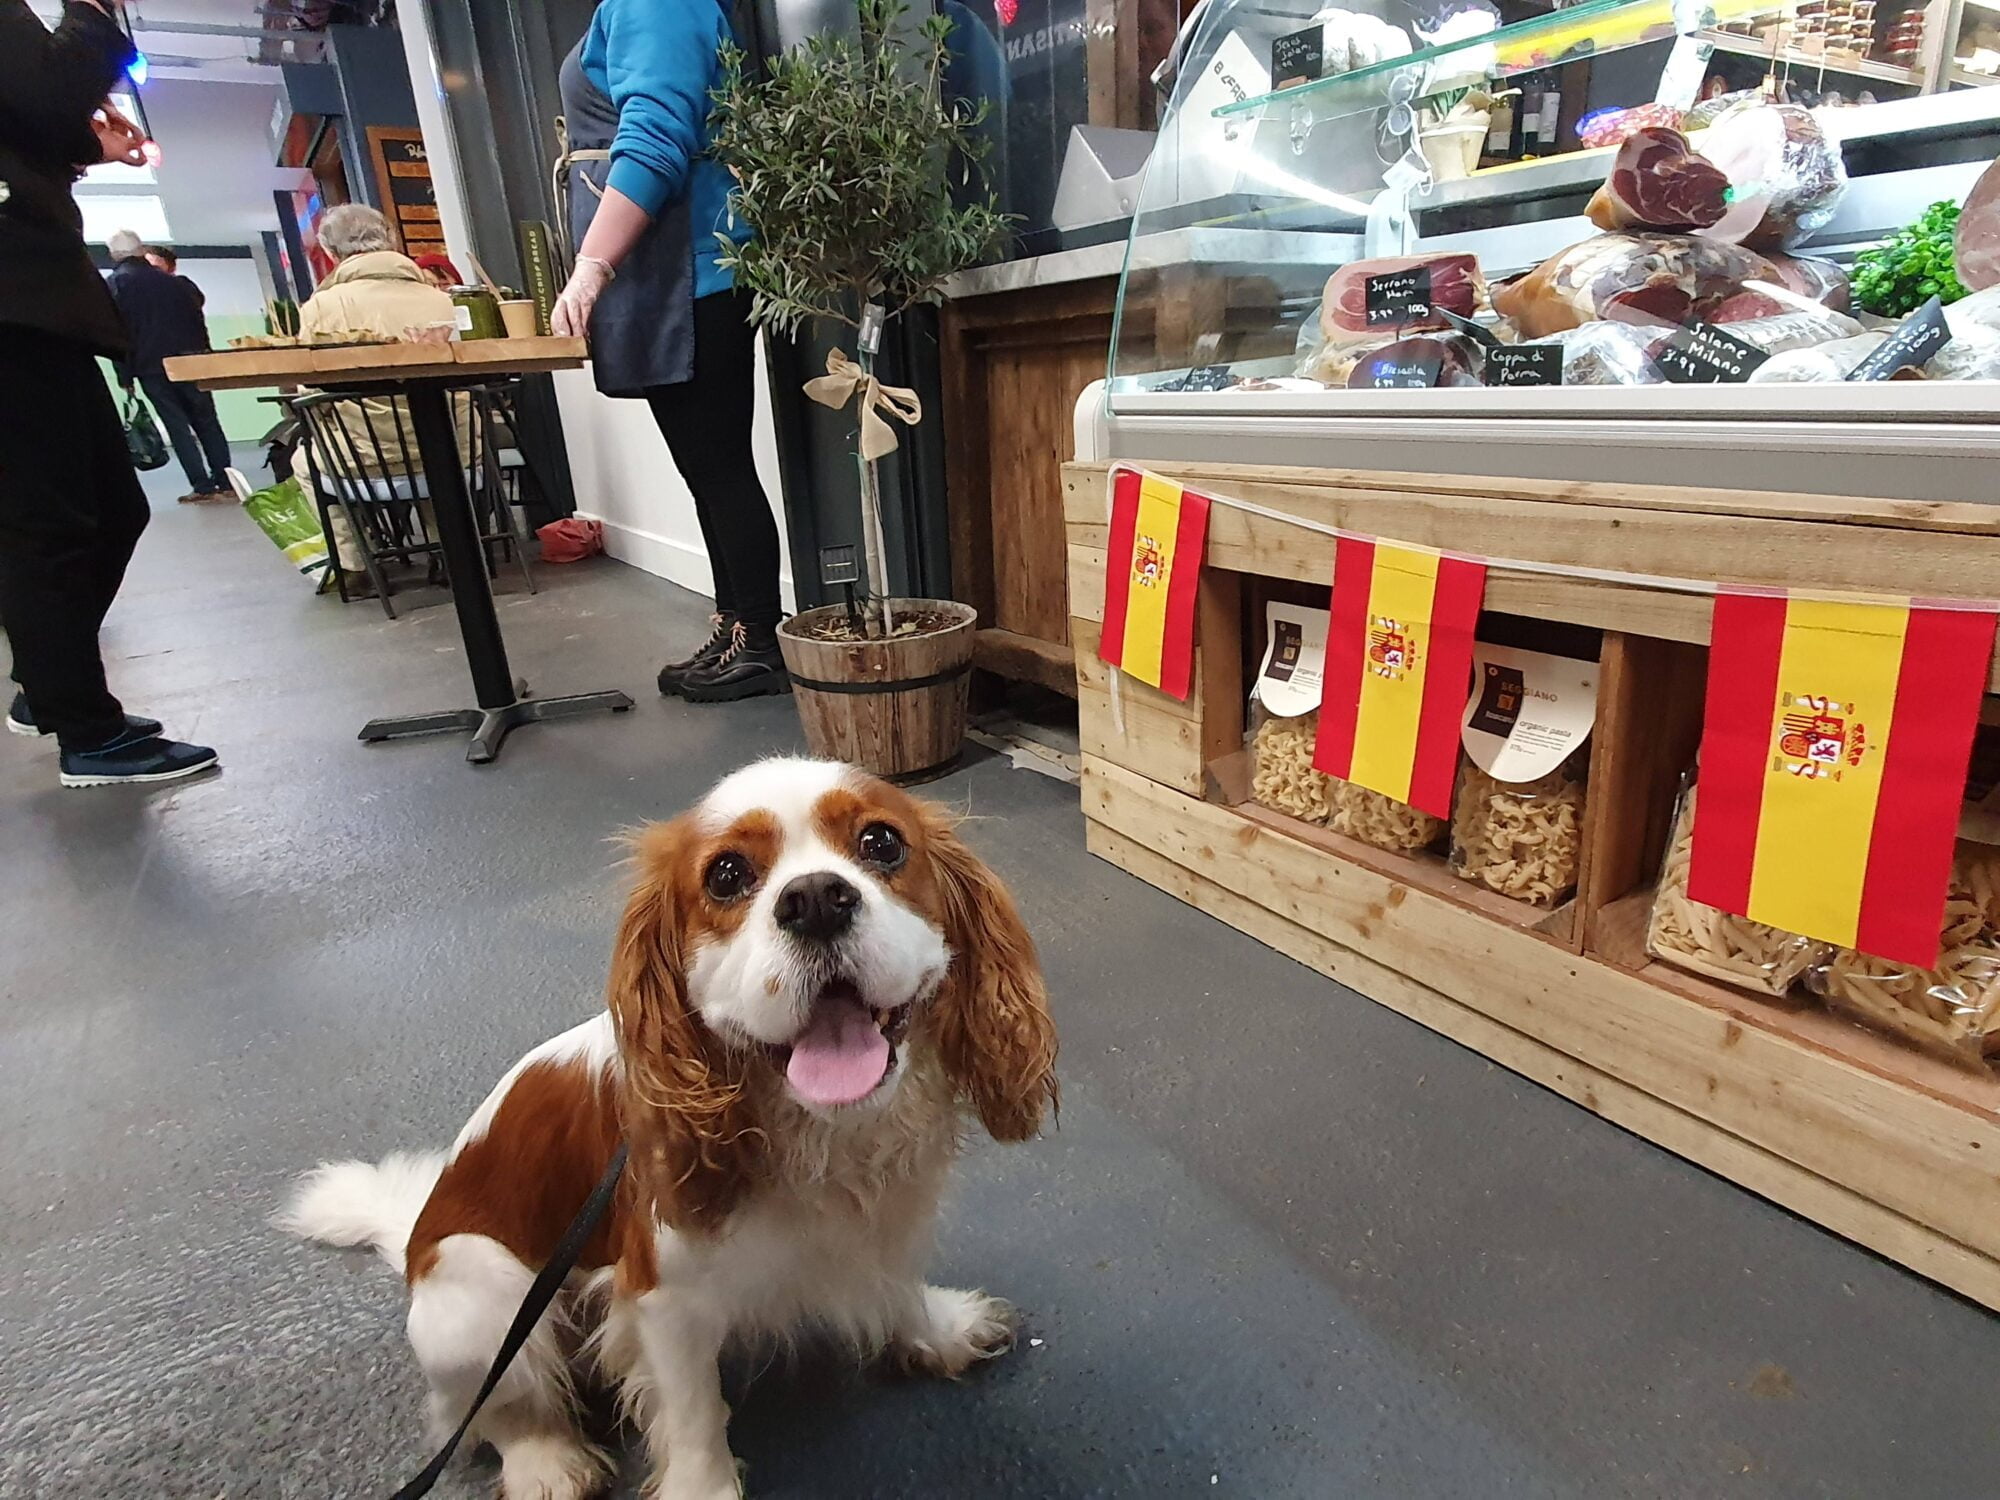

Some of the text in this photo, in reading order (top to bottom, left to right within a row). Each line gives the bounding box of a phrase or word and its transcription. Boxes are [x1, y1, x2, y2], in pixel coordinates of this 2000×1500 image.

[529, 230, 540, 263] BREAD
[1371, 279, 1416, 292] Serrano
[1408, 303, 1429, 318] 100g
[1690, 322, 1748, 360] Salame
[1907, 326, 1940, 353] 100g
[1491, 348, 1545, 367] Coppa di
[1688, 341, 1741, 375] Milano
[1501, 367, 1542, 382] Parma
[1519, 720, 1549, 734] organic
